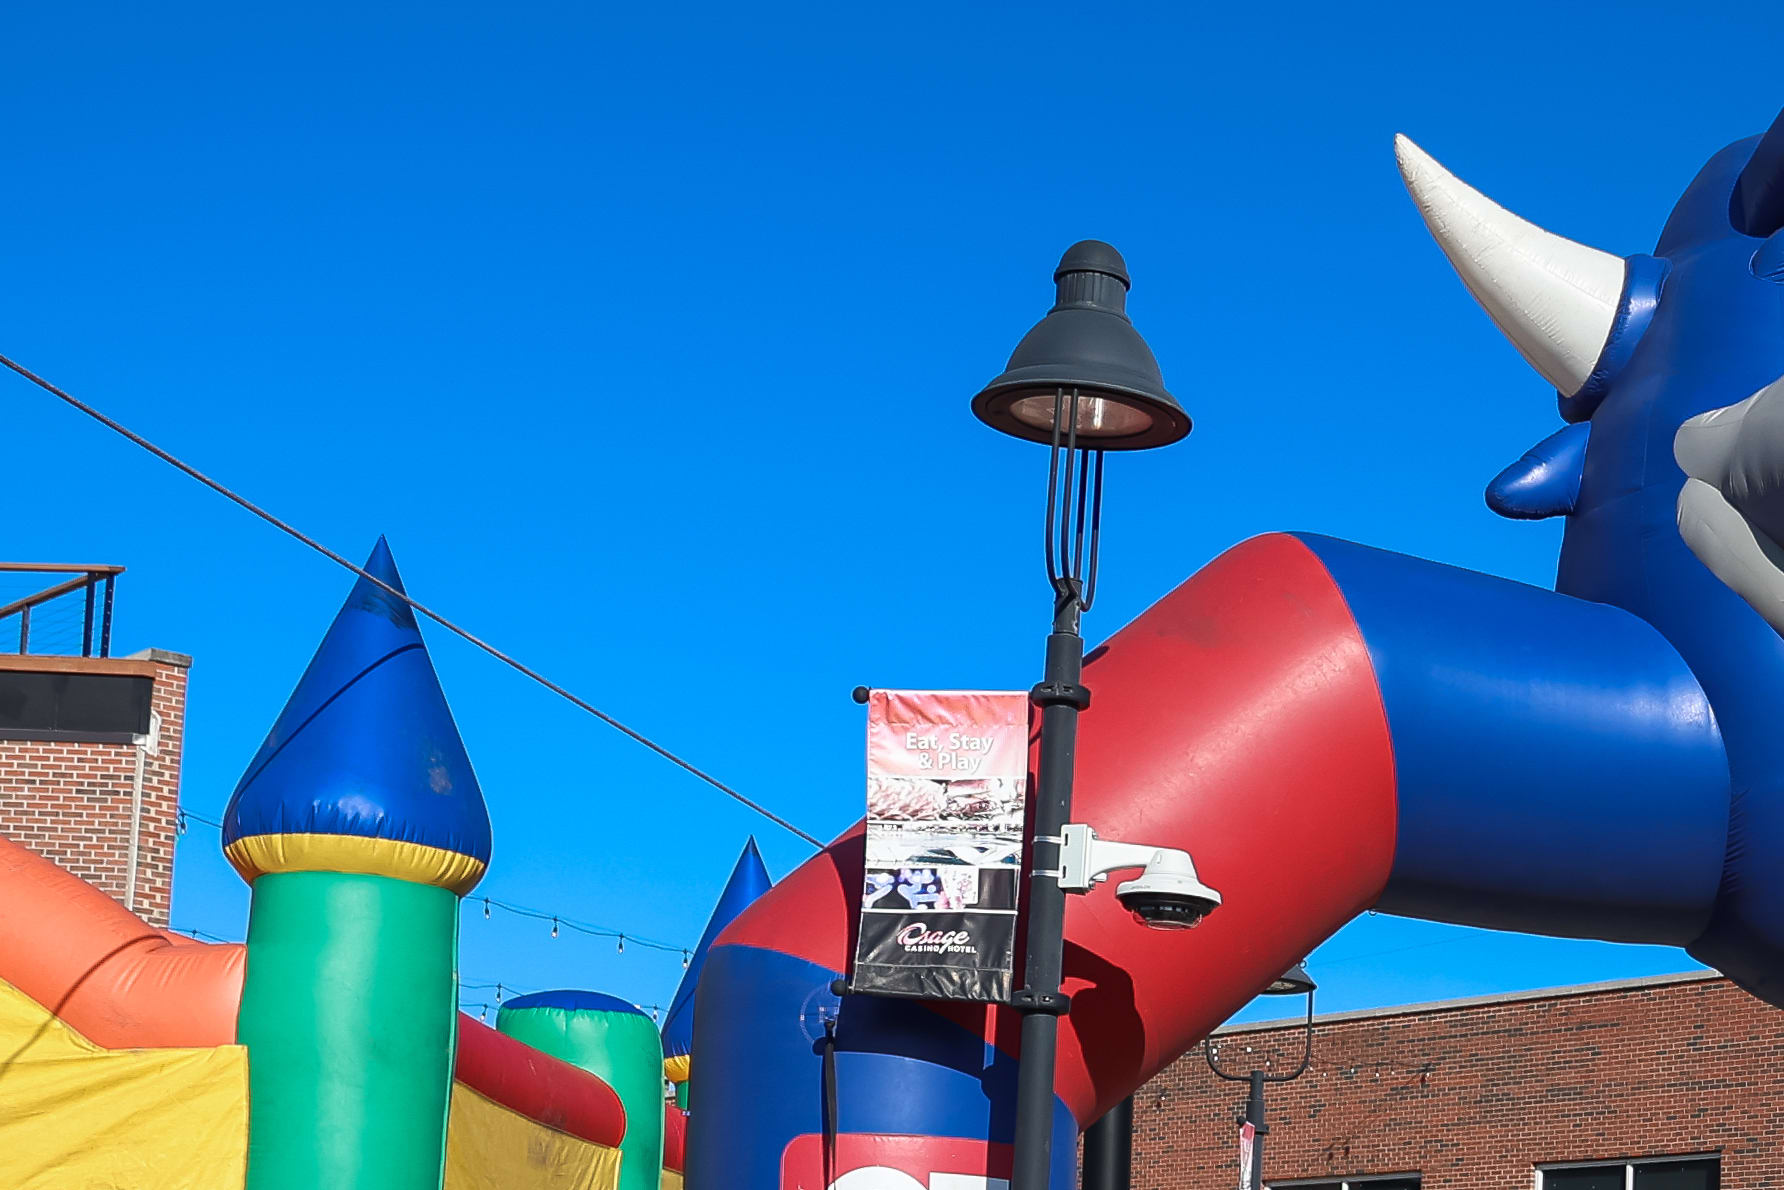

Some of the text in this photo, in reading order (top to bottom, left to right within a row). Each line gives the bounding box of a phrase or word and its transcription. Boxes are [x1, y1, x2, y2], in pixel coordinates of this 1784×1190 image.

[906, 732, 994, 753] Eat, Stay
[918, 753, 982, 774] & Play
[897, 922, 971, 954] Osage
[904, 944, 977, 954] CASINO HOTEL
